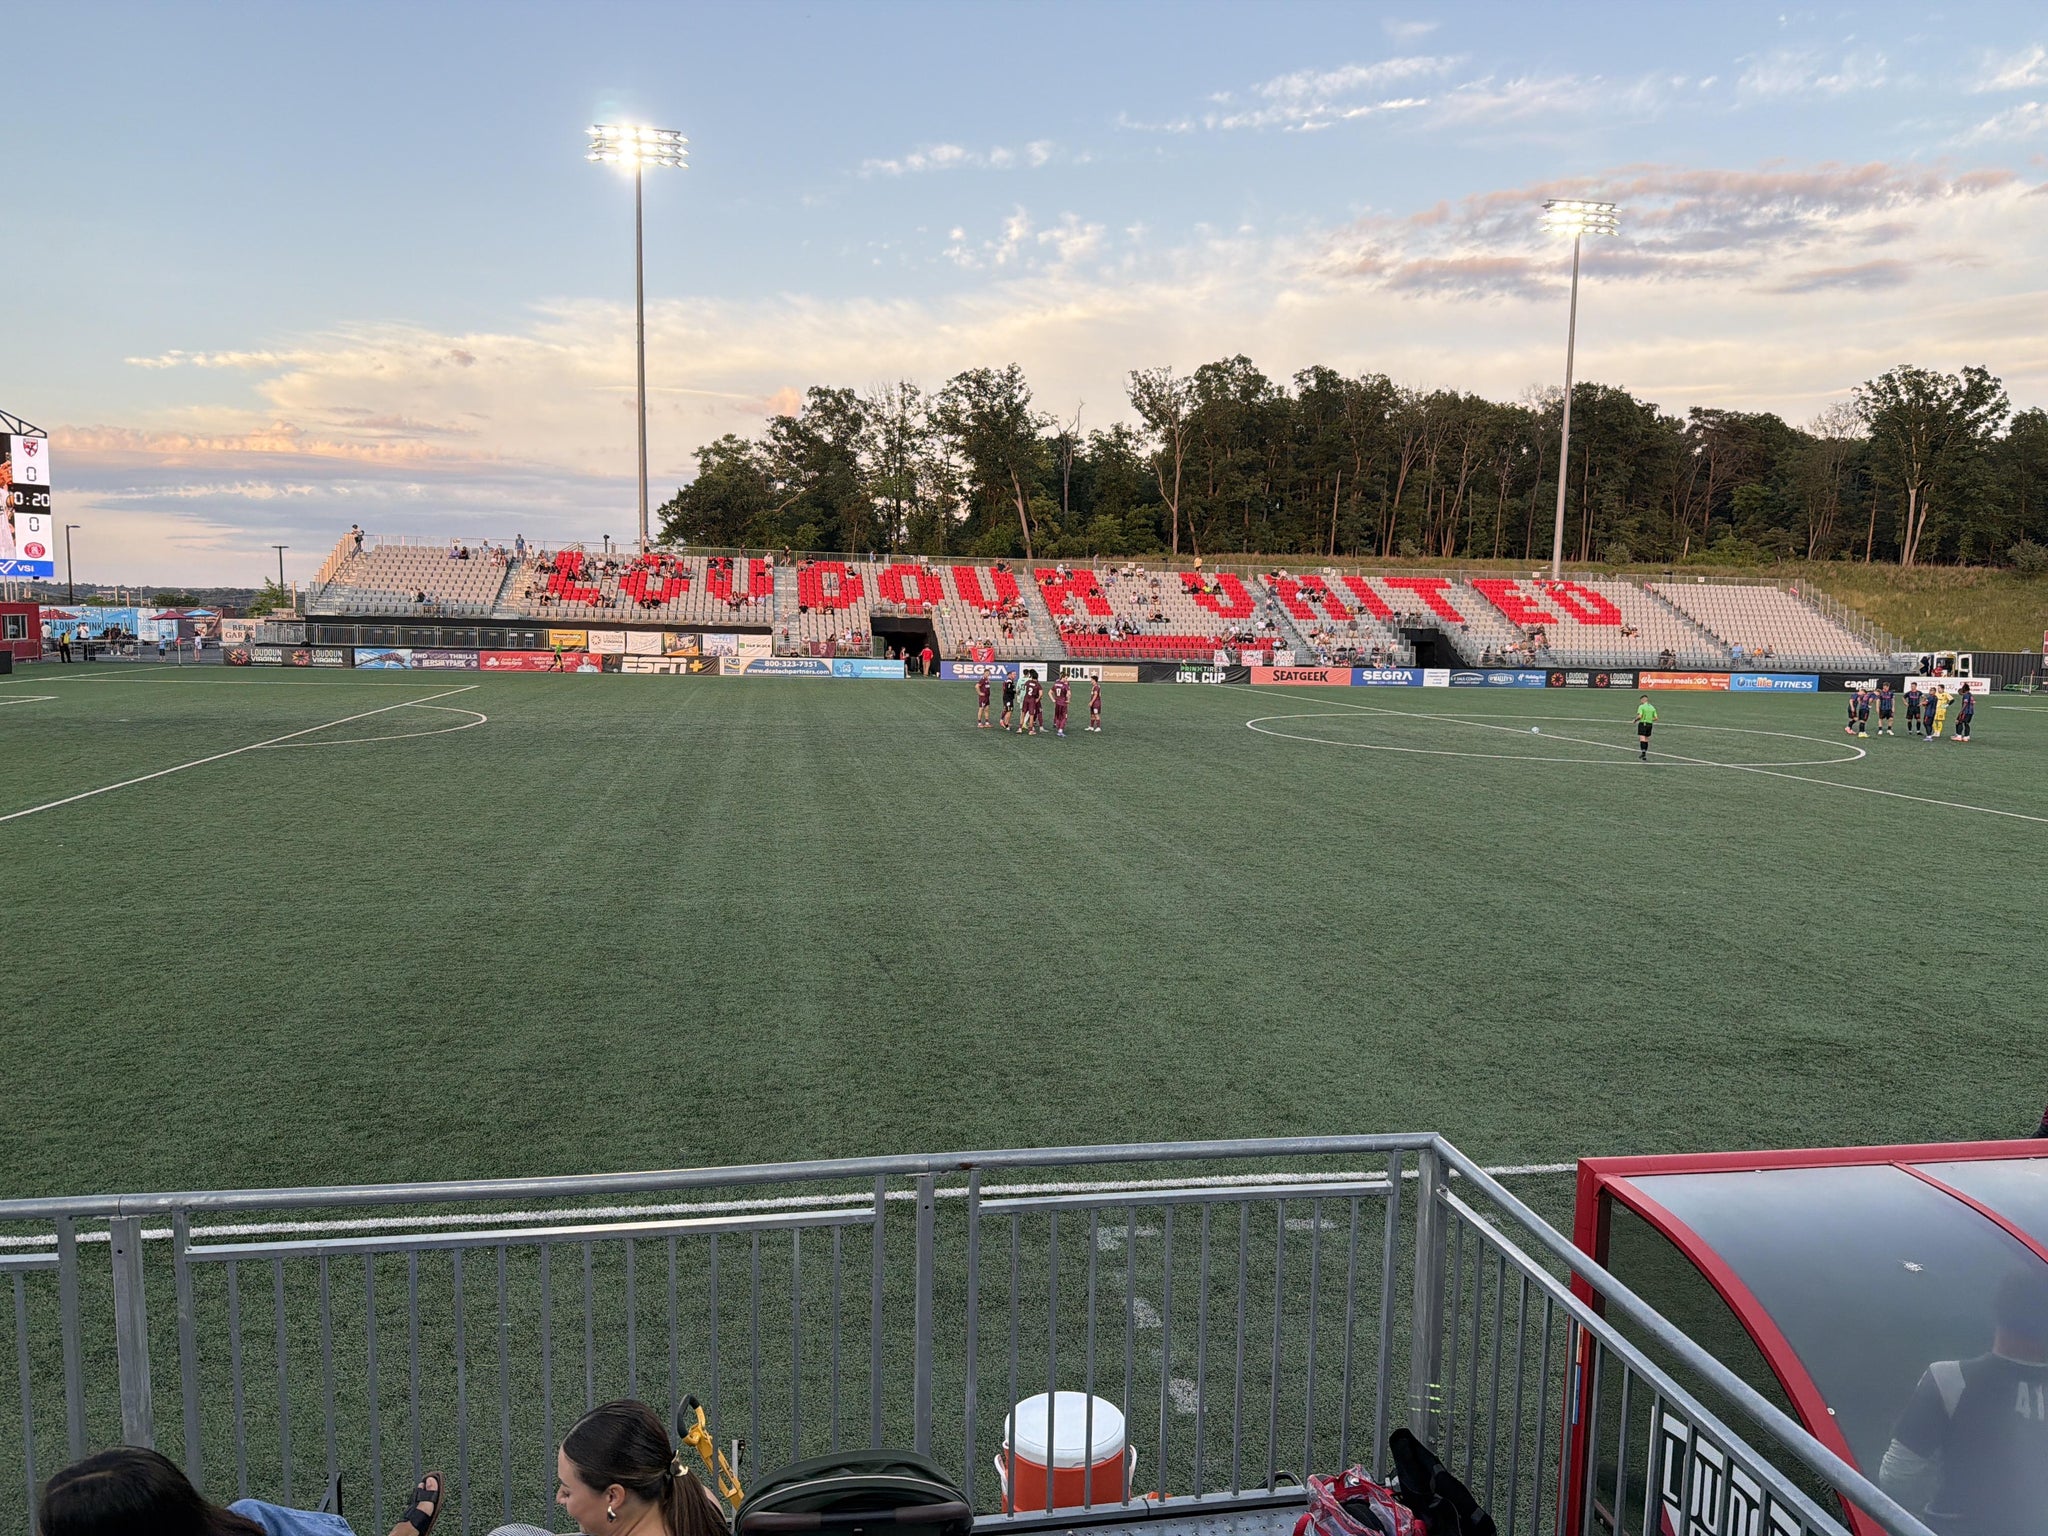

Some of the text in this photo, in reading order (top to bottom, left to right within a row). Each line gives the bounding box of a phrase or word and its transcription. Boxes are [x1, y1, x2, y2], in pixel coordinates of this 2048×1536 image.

[27, 467, 36, 481] 0
[14, 491, 50, 506] 0:20
[29, 517, 39, 532] 0
[55, 621, 76, 631] LONG
[250, 649, 282, 657] LOUDOUN
[311, 650, 343, 658] LOUDOUN
[764, 660, 818, 668] 800-323-7351
[952, 663, 1007, 675] SEGRA
[747, 668, 830, 676] www.dcatechpartners.com
[1272, 670, 1329, 682] SEATGEEK
[1362, 670, 1413, 681] SEGRA
[1176, 672, 1226, 684] USL CUP
[1774, 680, 1813, 689] FITNESS
[1844, 678, 1878, 691] capelli
[1028, 687, 1034, 696] 2
